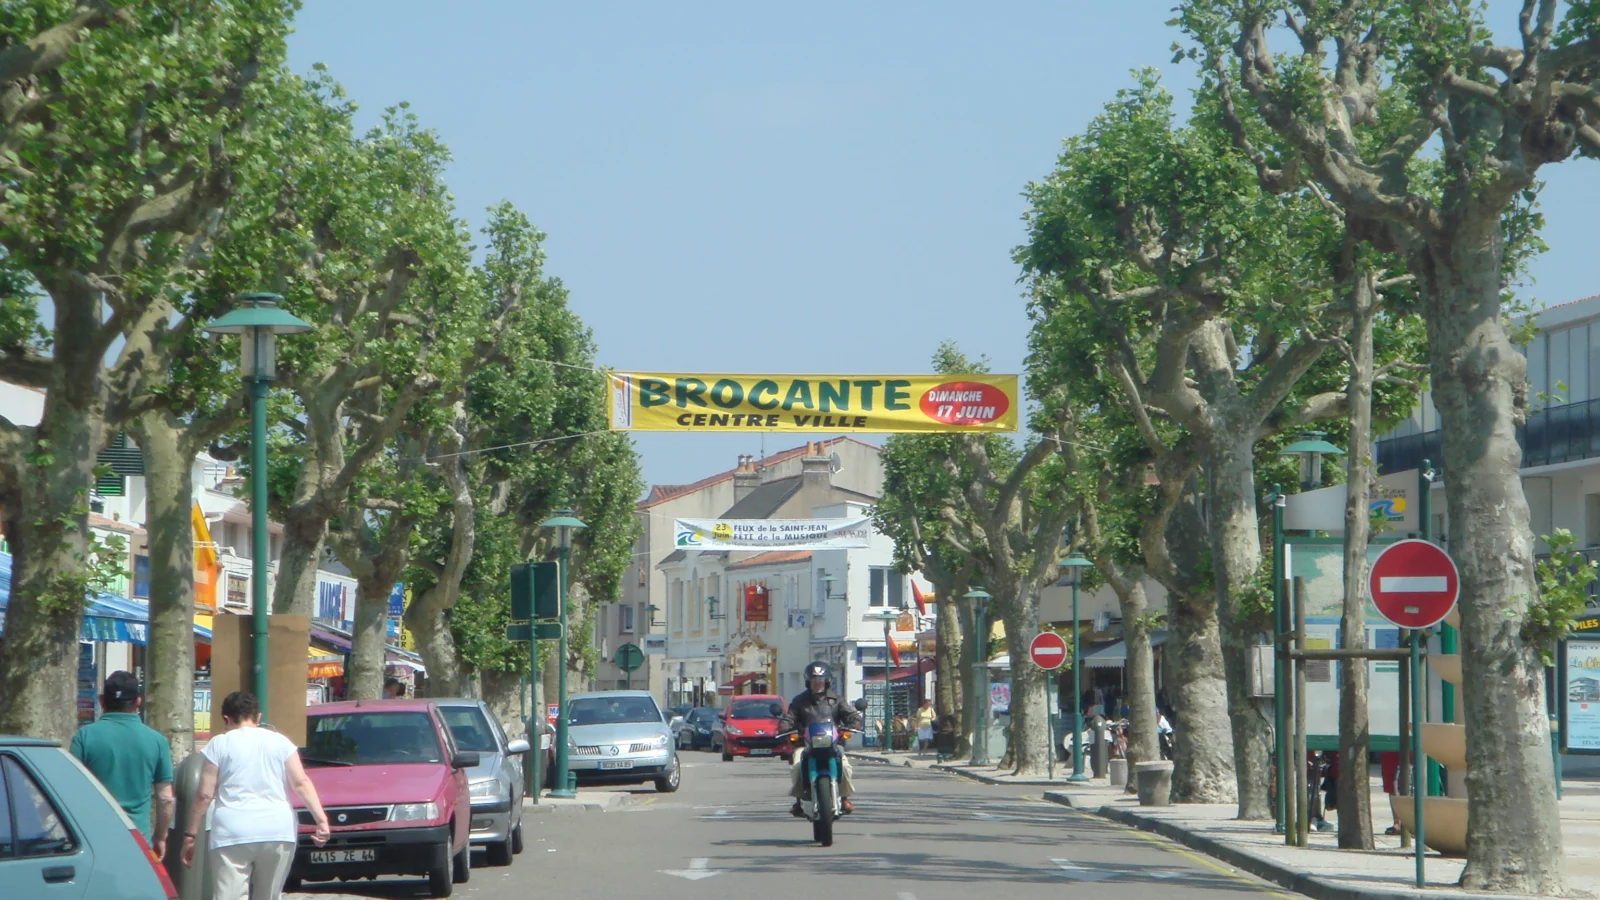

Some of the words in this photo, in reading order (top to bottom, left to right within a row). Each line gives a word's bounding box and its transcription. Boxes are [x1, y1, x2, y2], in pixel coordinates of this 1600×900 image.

[639, 378, 911, 412] BROCANTE
[928, 390, 982, 402] DIMANCHE
[937, 405, 953, 418] 17
[956, 406, 995, 419] JUIN
[677, 413, 780, 427] CENTRE
[793, 414, 868, 427] VILLE
[715, 523, 727, 531] 23
[757, 524, 768, 532] de
[769, 524, 777, 532] la
[780, 524, 828, 532] SAINT-JEAN
[712, 532, 730, 540] Juin
[733, 532, 754, 541] FÊTE
[757, 533, 769, 541] de
[772, 533, 780, 541] la
[784, 532, 828, 541] MUSIQUE
[312, 851, 336, 863] 4415
[343, 850, 355, 861] ZE
[361, 849, 374, 861] 44
